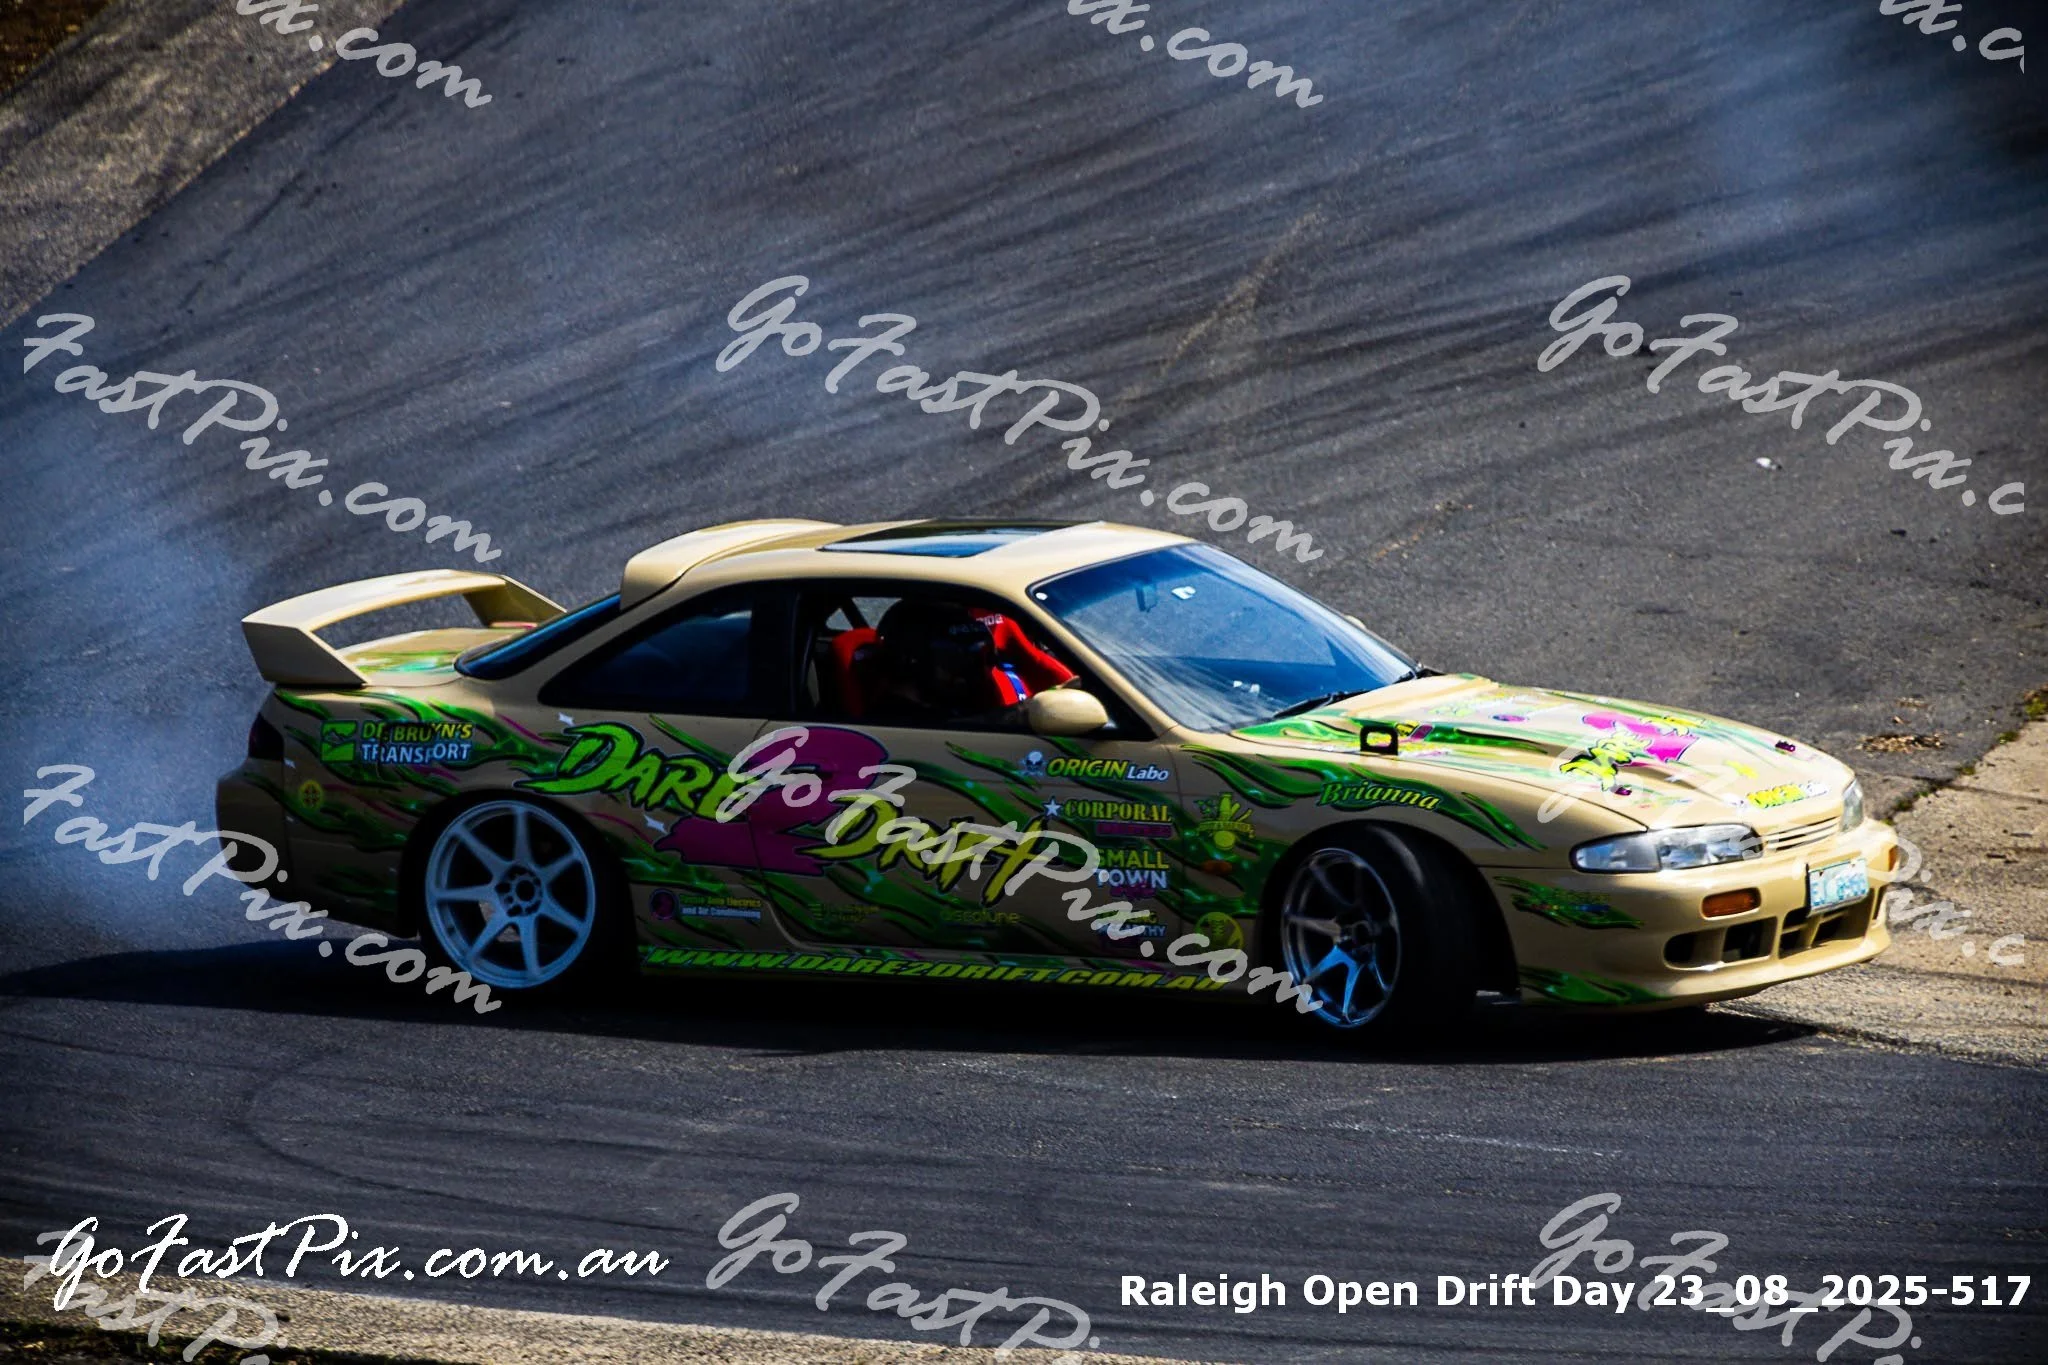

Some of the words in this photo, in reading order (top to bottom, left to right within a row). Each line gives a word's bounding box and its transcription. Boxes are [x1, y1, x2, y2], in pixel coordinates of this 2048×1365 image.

[362, 741, 472, 764] TRANSPORT
[1047, 758, 1128, 778] ORIGIN
[1127, 765, 1169, 781] Labo
[1318, 781, 1441, 810] Brianna
[1064, 800, 1171, 822] CORPORAL
